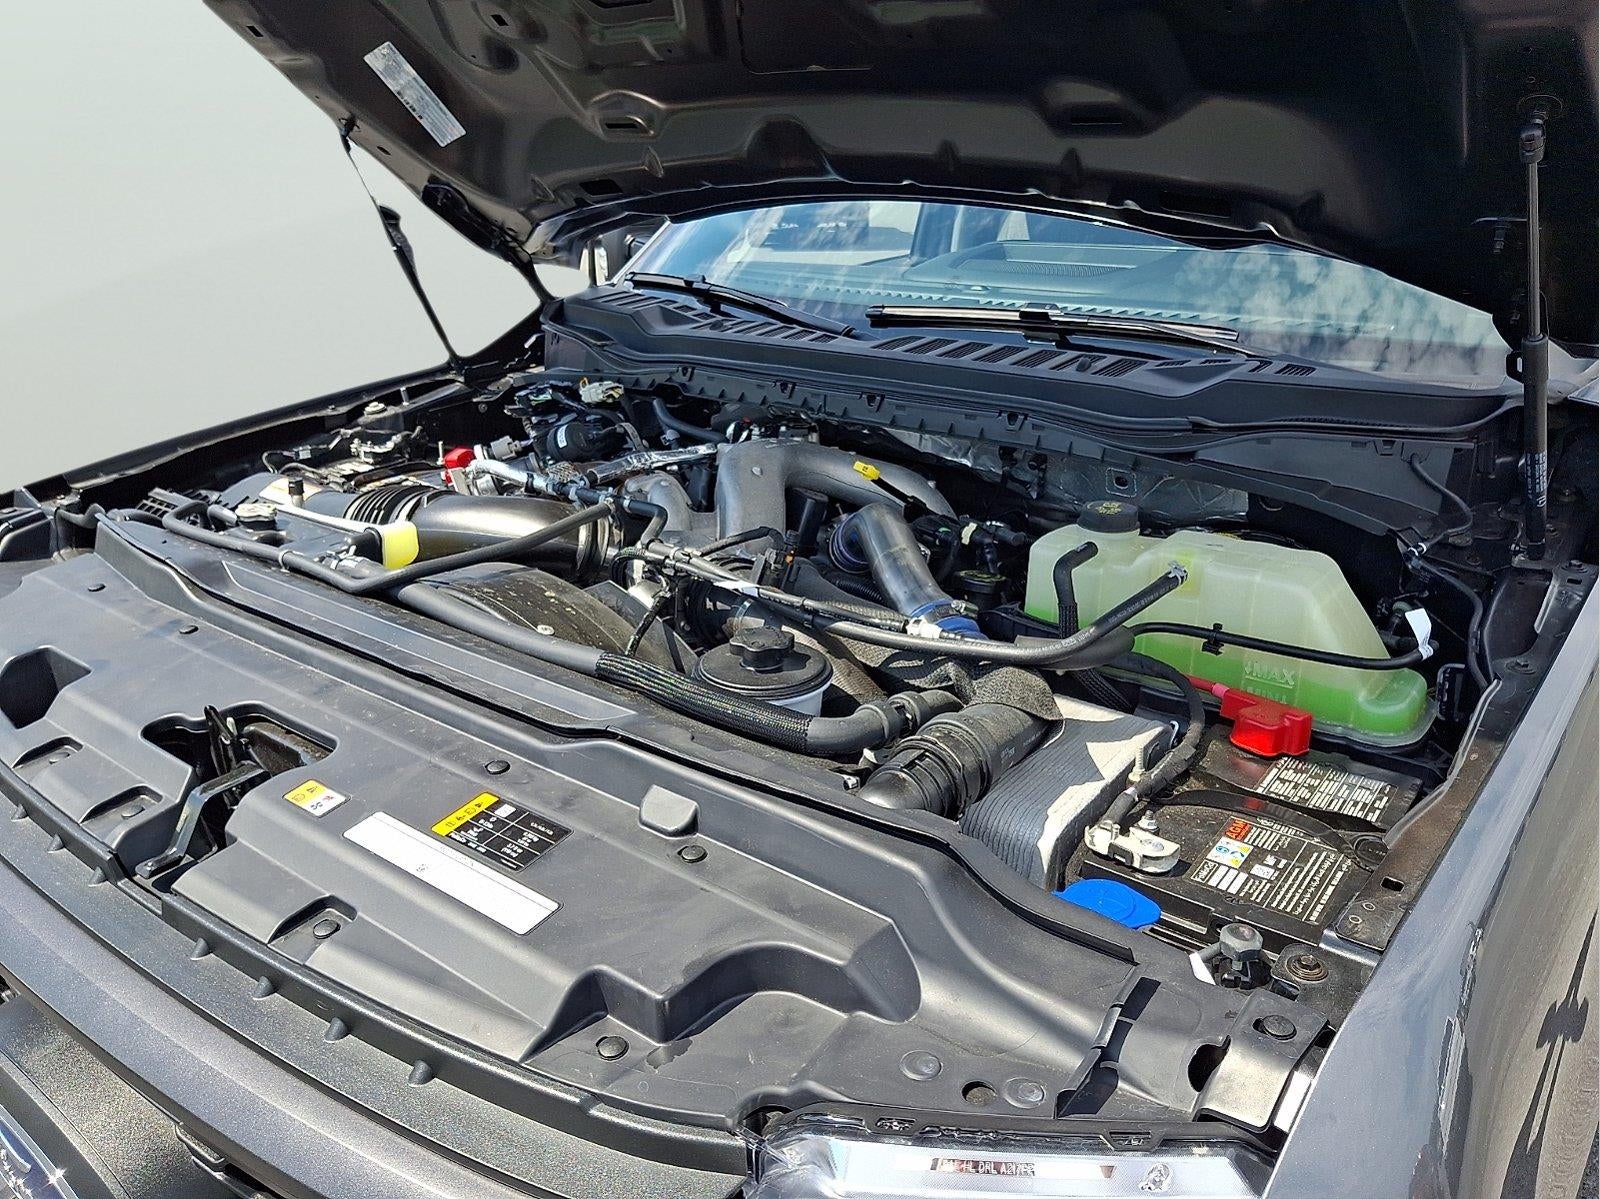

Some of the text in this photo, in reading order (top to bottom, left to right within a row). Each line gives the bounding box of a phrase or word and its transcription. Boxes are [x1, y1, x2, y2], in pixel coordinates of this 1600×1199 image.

[1252, 660, 1295, 685] MAX
[1225, 819, 1246, 839] AGM
[978, 1161, 998, 1175] DRL
